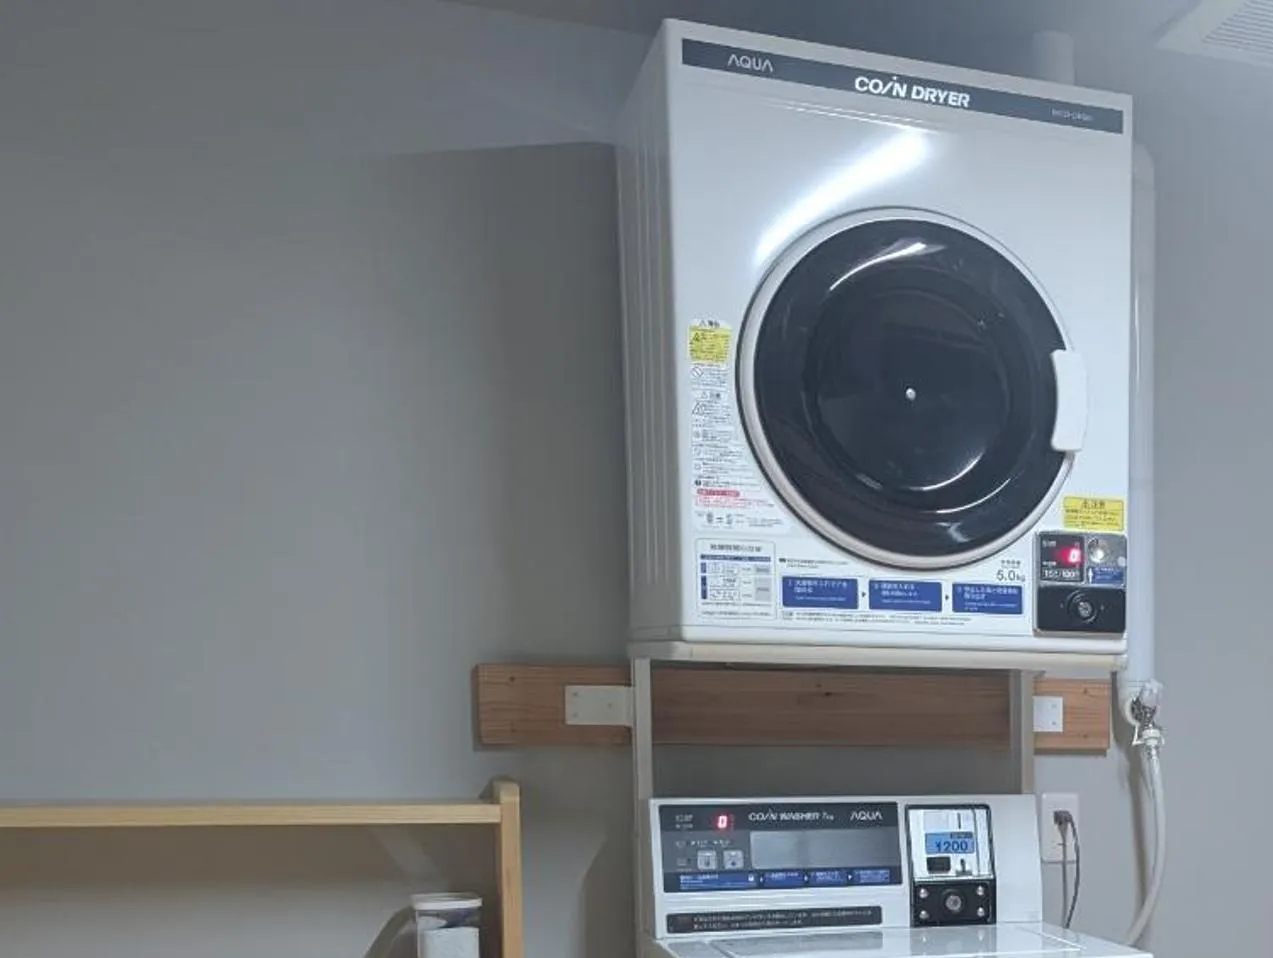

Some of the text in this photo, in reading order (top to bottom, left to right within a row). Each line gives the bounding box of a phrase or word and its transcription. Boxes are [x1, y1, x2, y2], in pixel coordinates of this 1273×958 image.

[728, 53, 774, 73] AQUA
[854, 75, 971, 107] COIN DRYER
